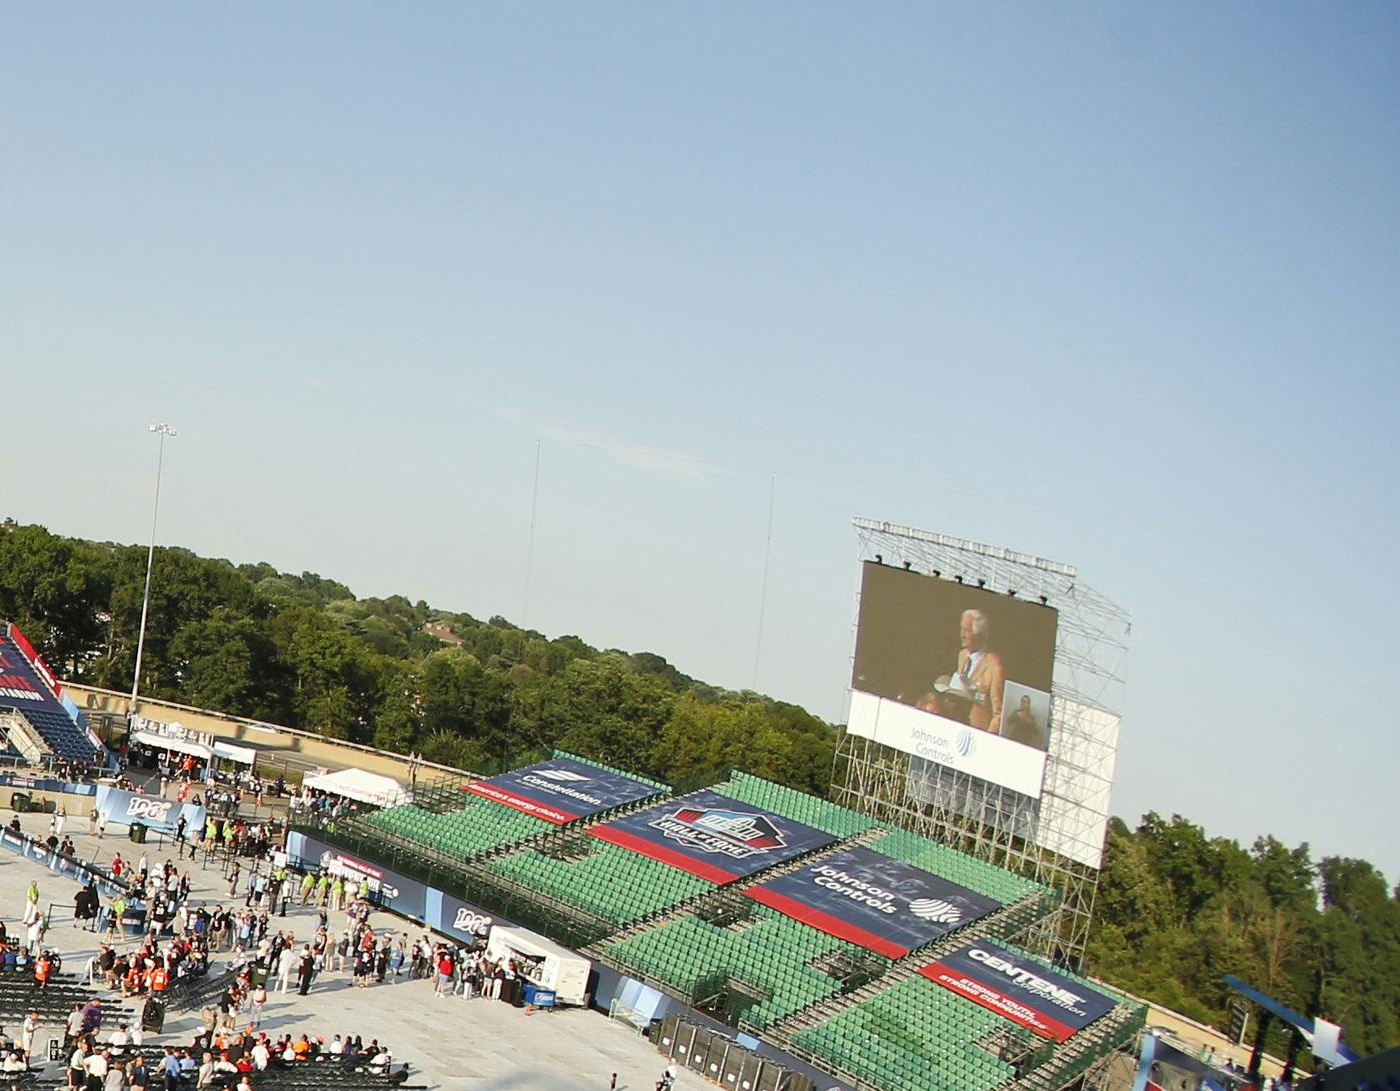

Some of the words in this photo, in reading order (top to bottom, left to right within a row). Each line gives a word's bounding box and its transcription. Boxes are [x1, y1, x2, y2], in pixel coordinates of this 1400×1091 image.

[911, 727, 949, 748] Johnson
[915, 742, 955, 765] Controls
[522, 775, 601, 806] Constellation
[661, 820, 697, 838] HALL
[704, 837, 750, 856] FAME
[809, 864, 897, 901] Johnson
[813, 876, 898, 915] Controls
[939, 974, 980, 996] STRONG
[967, 949, 1085, 1006] CENTENE
[961, 978, 1001, 1000] STRONG
[1001, 998, 1036, 1019] YOUTH,
